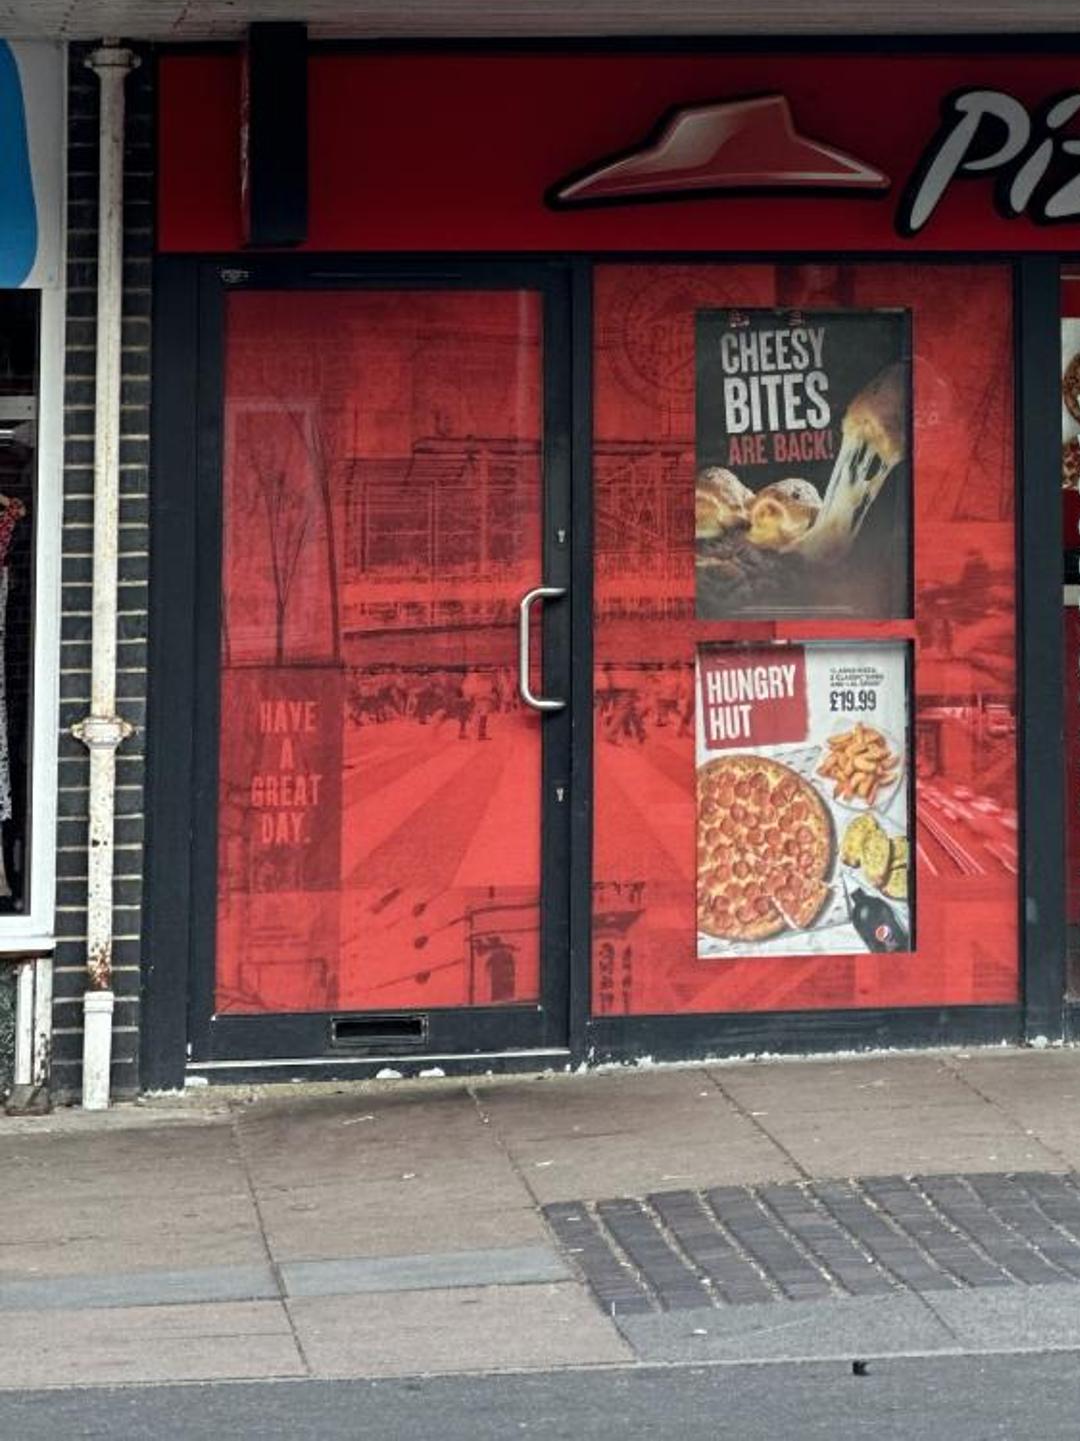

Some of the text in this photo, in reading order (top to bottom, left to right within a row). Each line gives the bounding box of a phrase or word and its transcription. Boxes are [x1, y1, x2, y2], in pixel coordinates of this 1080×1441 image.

[720, 327, 825, 374] CHEESY
[723, 371, 831, 433] BITES
[729, 429, 834, 466] ARE BACK!
[706, 664, 796, 705] HUNGRY
[829, 690, 877, 712] £19.99
[260, 701, 318, 733] HAVE
[710, 704, 752, 741] HUT
[279, 737, 295, 771] A
[251, 773, 322, 808] GREAT
[261, 811, 312, 845] DAY.
